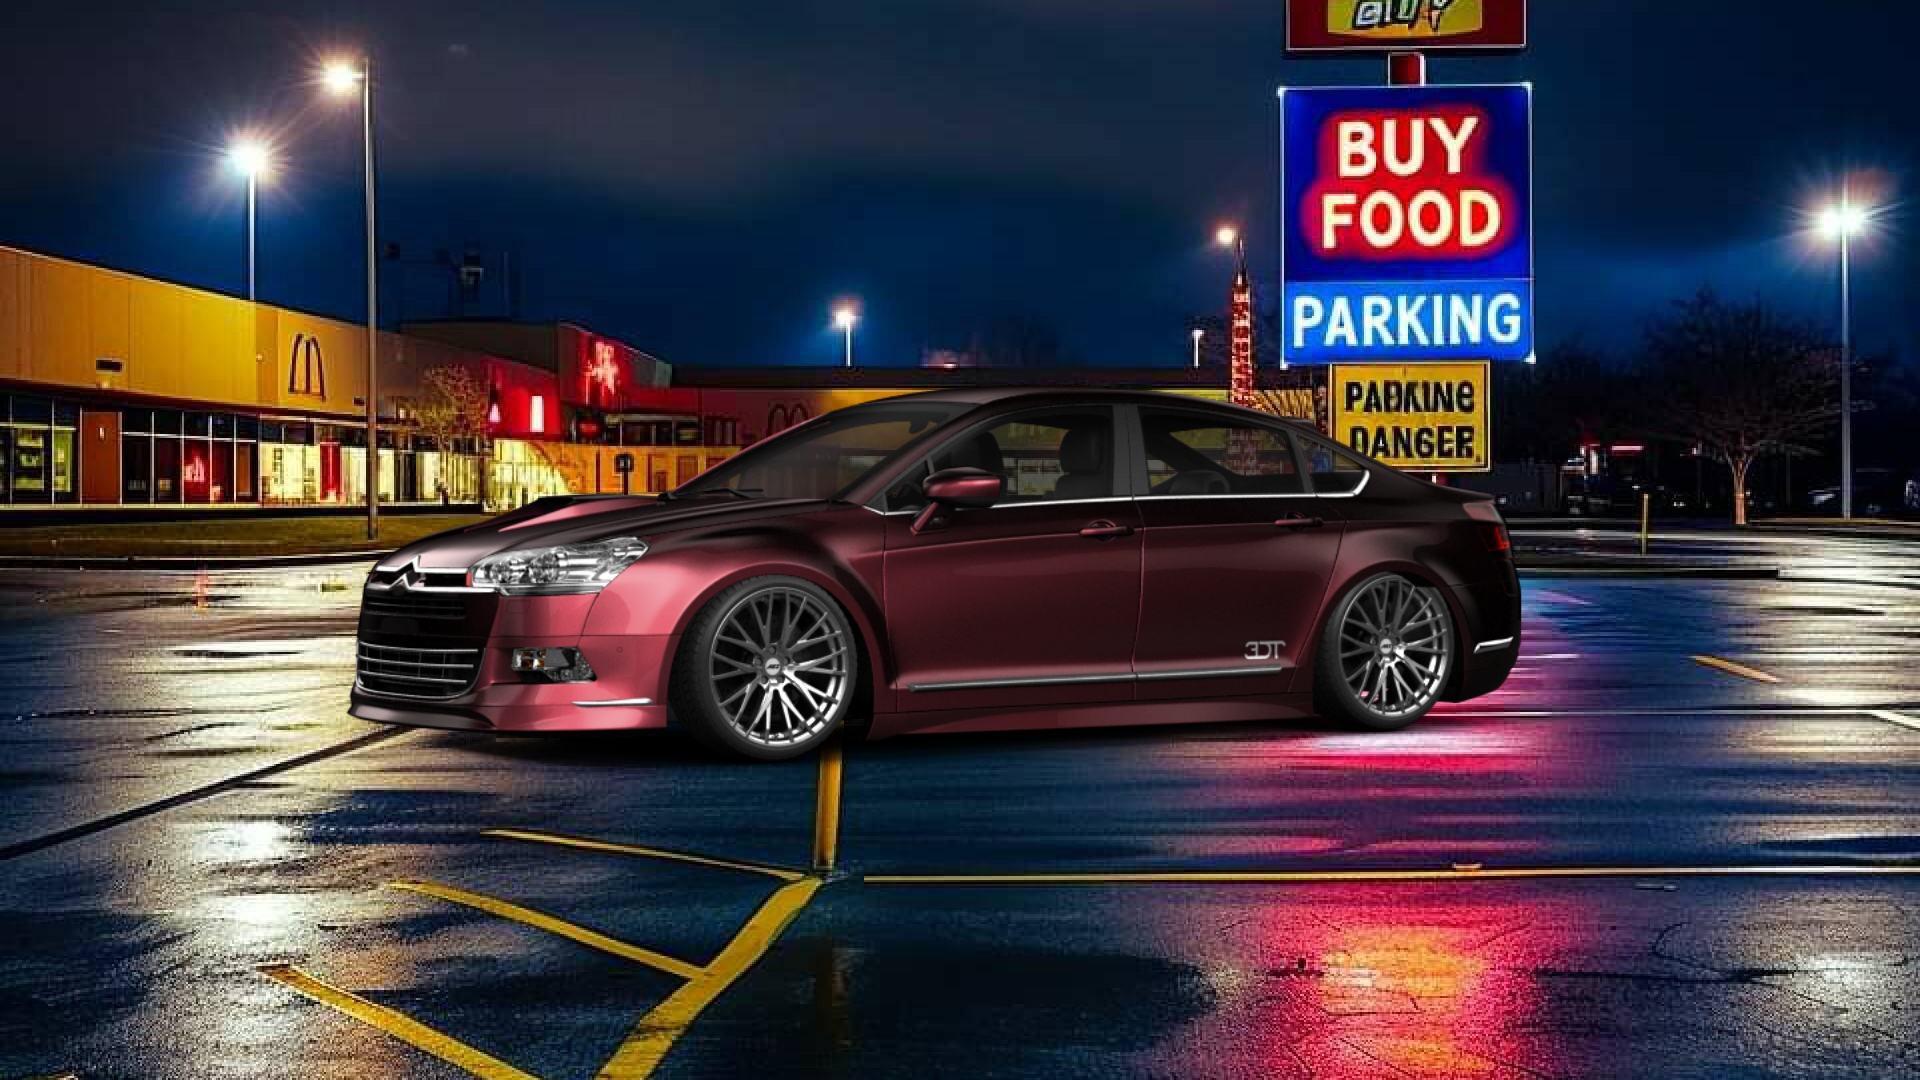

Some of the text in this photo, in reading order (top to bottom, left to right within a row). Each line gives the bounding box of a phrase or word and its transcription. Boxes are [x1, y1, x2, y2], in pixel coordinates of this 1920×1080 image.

[1338, 116, 1479, 177] BUY
[1321, 189, 1501, 249] FOOD
[1292, 292, 1522, 349] PARKING
[1350, 425, 1475, 459] DANGER
[1244, 640, 1286, 660] 3DT
